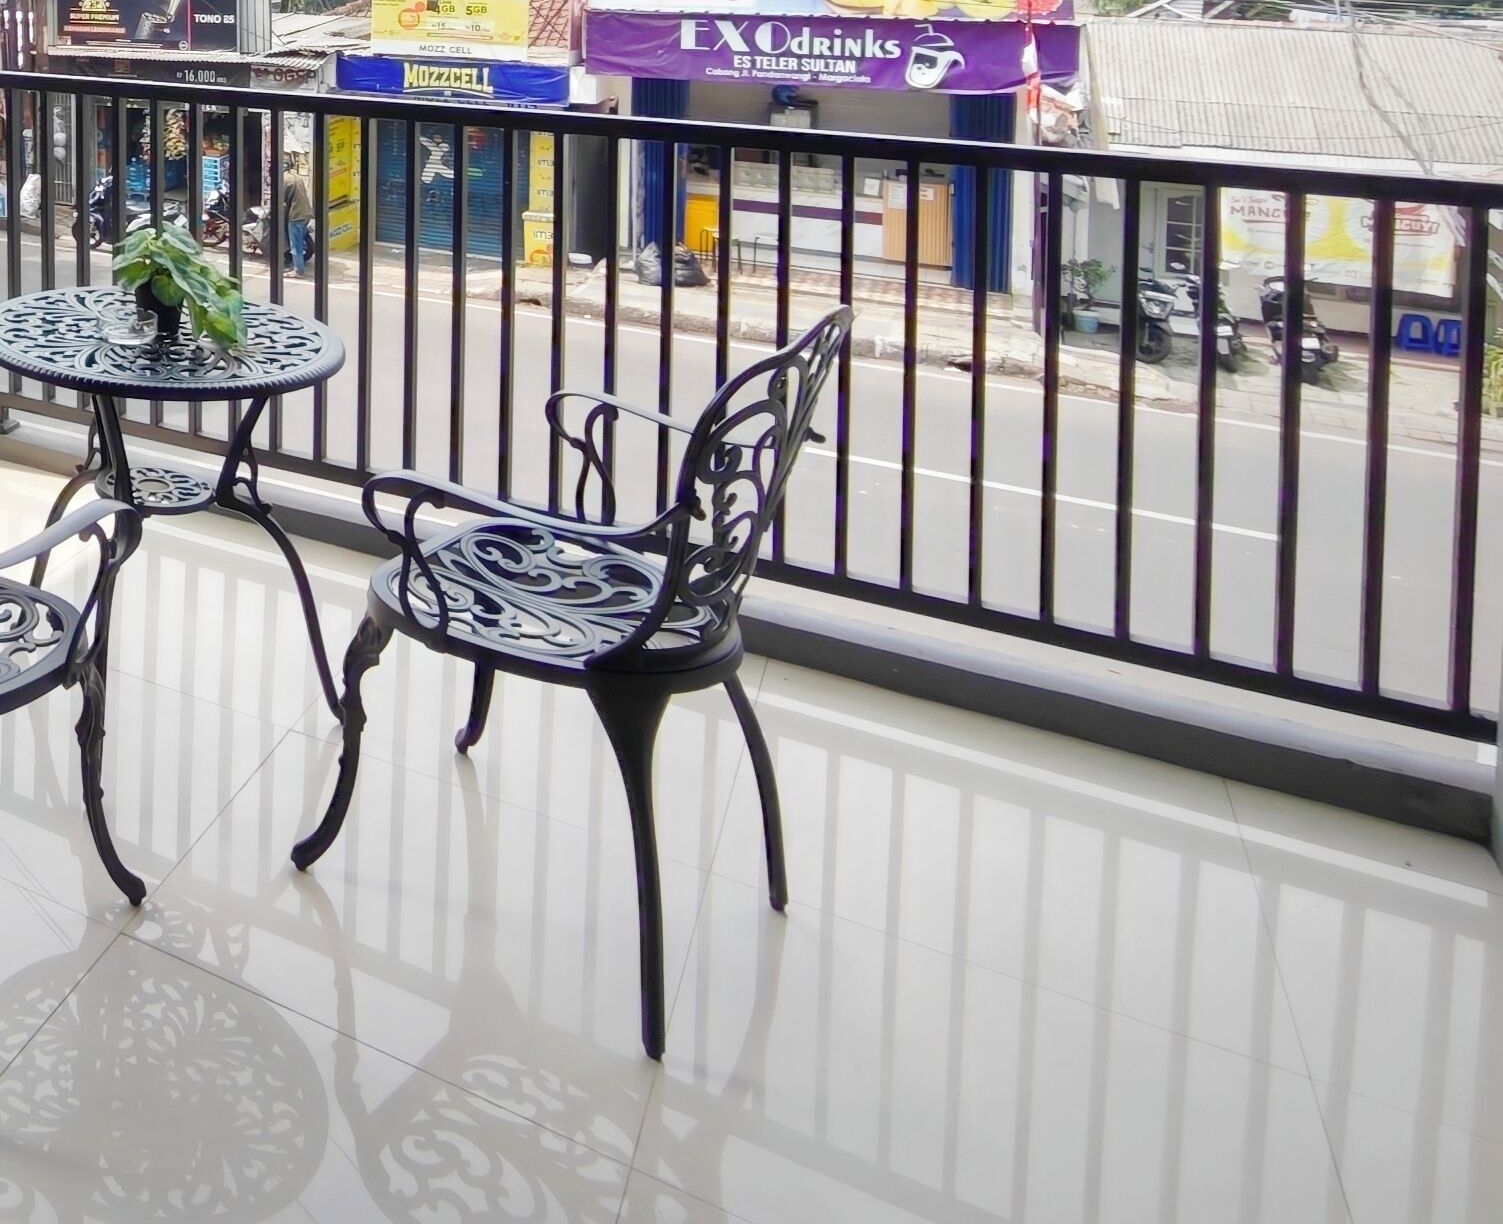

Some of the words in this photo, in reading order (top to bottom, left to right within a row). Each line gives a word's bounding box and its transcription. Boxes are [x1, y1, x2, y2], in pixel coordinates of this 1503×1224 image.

[466, 5, 487, 15] 5GB
[193, 14, 222, 24] TONO
[419, 45, 446, 53] MOZZ
[449, 46, 472, 54] CELL
[734, 55, 752, 68] ES
[754, 56, 798, 71] TELER
[801, 59, 856, 73] SULTAN
[184, 69, 216, 82] 16.000
[403, 62, 494, 93] MOZZCELL
